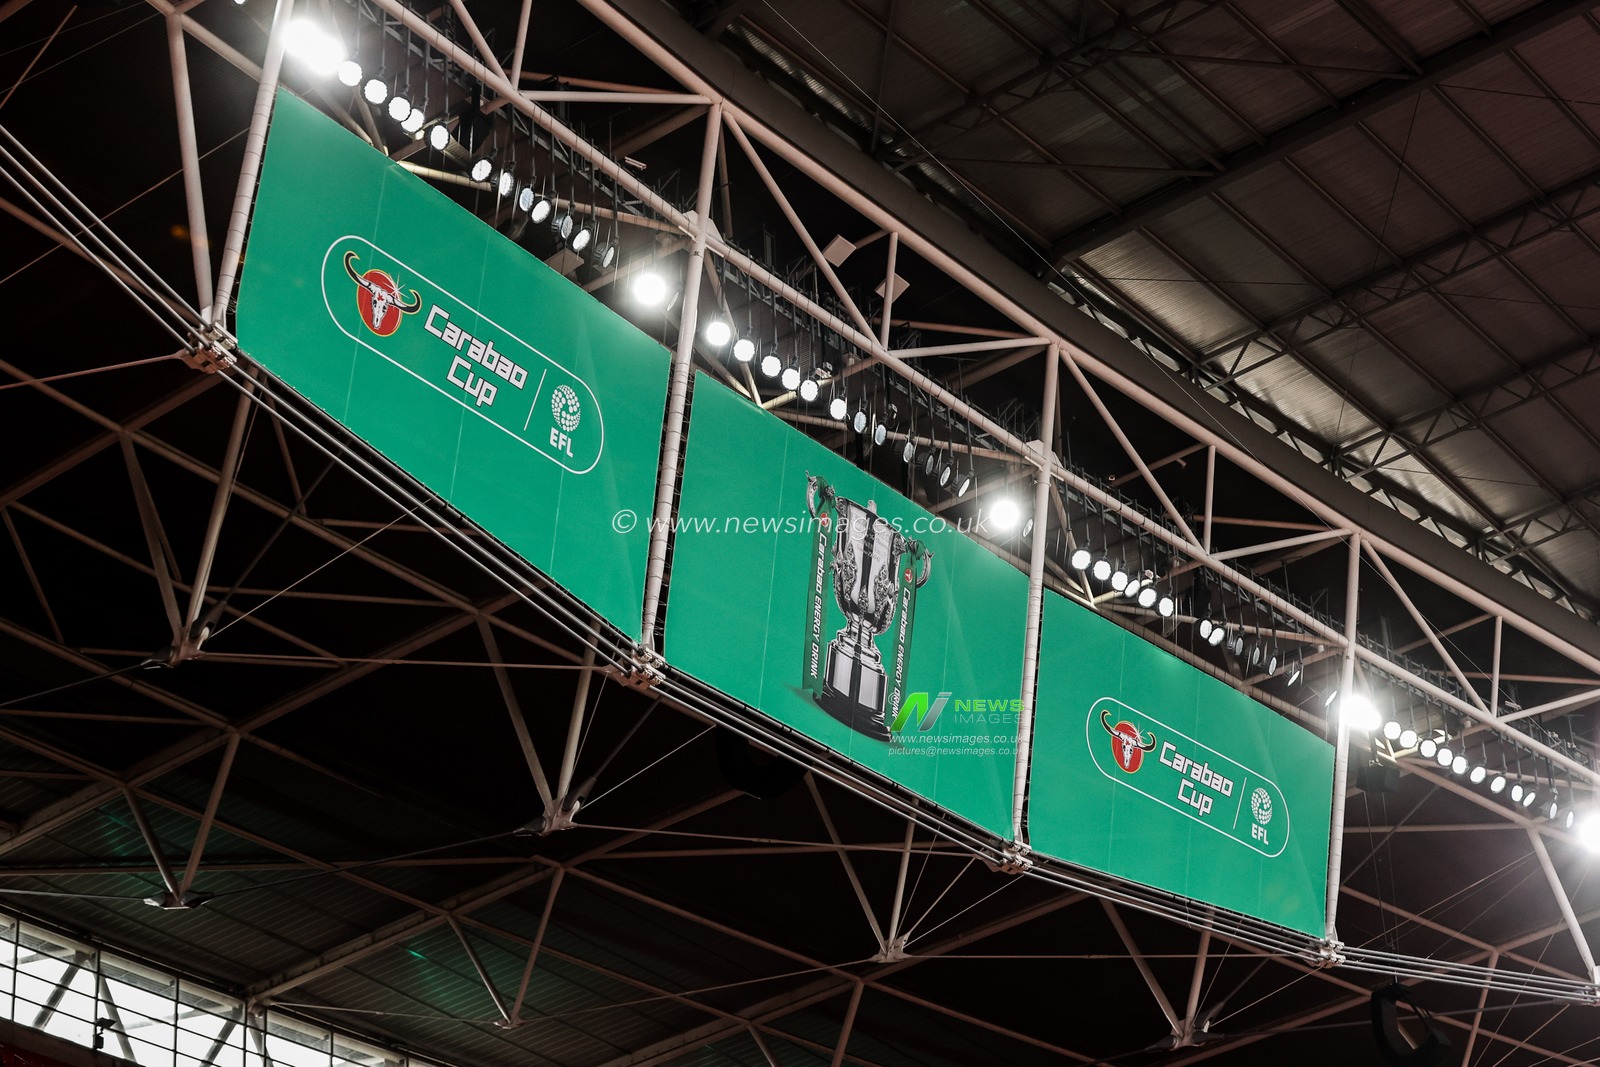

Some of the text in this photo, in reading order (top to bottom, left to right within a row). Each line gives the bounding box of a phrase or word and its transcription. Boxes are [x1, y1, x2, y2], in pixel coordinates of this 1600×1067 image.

[424, 303, 529, 390] Carabao
[446, 354, 498, 408] Cup
[549, 426, 574, 458] EFL
[810, 533, 828, 679] Carabao ENERGY DRINK
[899, 587, 911, 644] Carabao
[895, 644, 905, 690] ENERGY
[1159, 740, 1234, 798] Carabao
[1177, 778, 1214, 816] Cup
[1251, 823, 1269, 845] EFL
